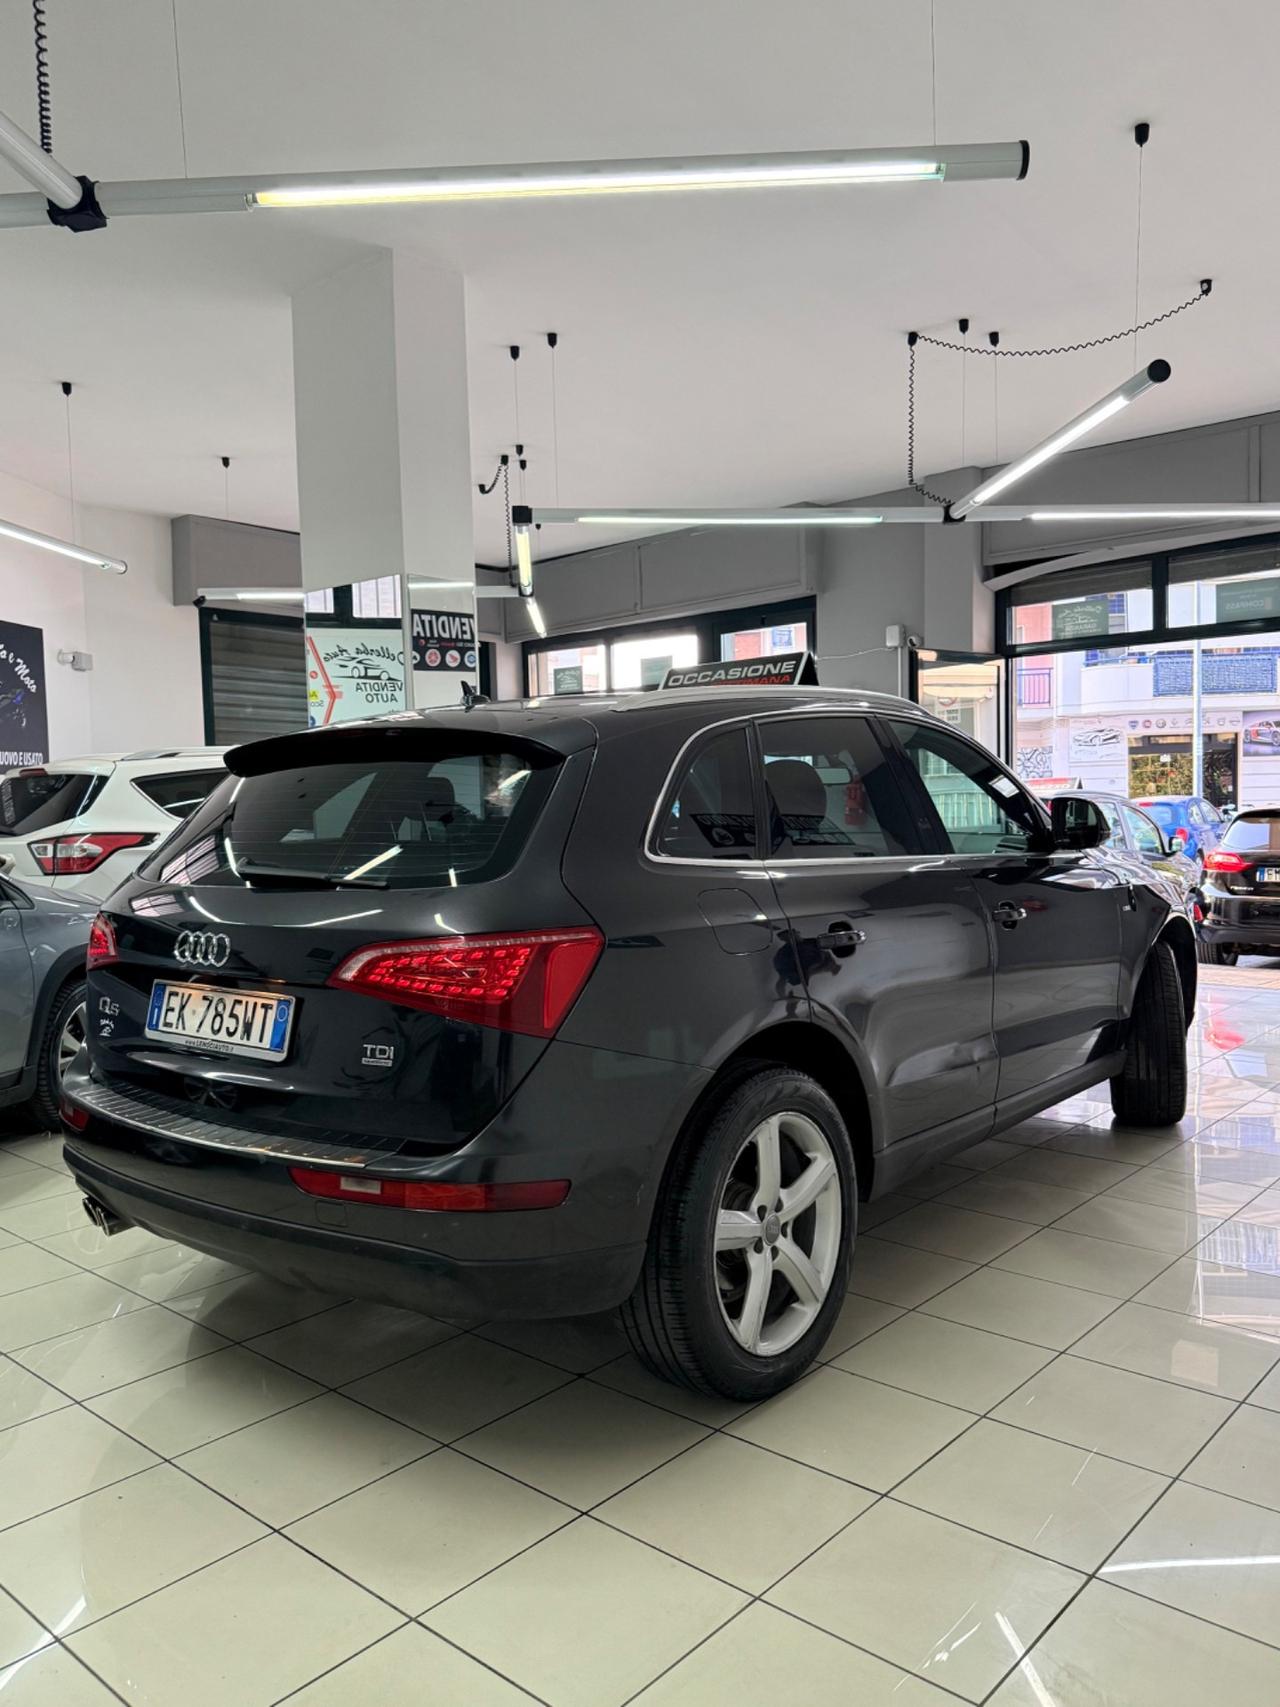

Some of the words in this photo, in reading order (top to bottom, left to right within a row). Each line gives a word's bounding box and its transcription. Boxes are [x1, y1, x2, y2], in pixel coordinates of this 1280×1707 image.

[14, 658, 37, 693] Moto
[668, 661, 797, 687] OCCASIONE
[19, 751, 23, 766] E
[23, 751, 43, 766] USATO
[99, 997, 120, 1016] Q5
[162, 990, 192, 1031] EK
[196, 995, 273, 1043] 785WT
[363, 1044, 394, 1059] TDI
